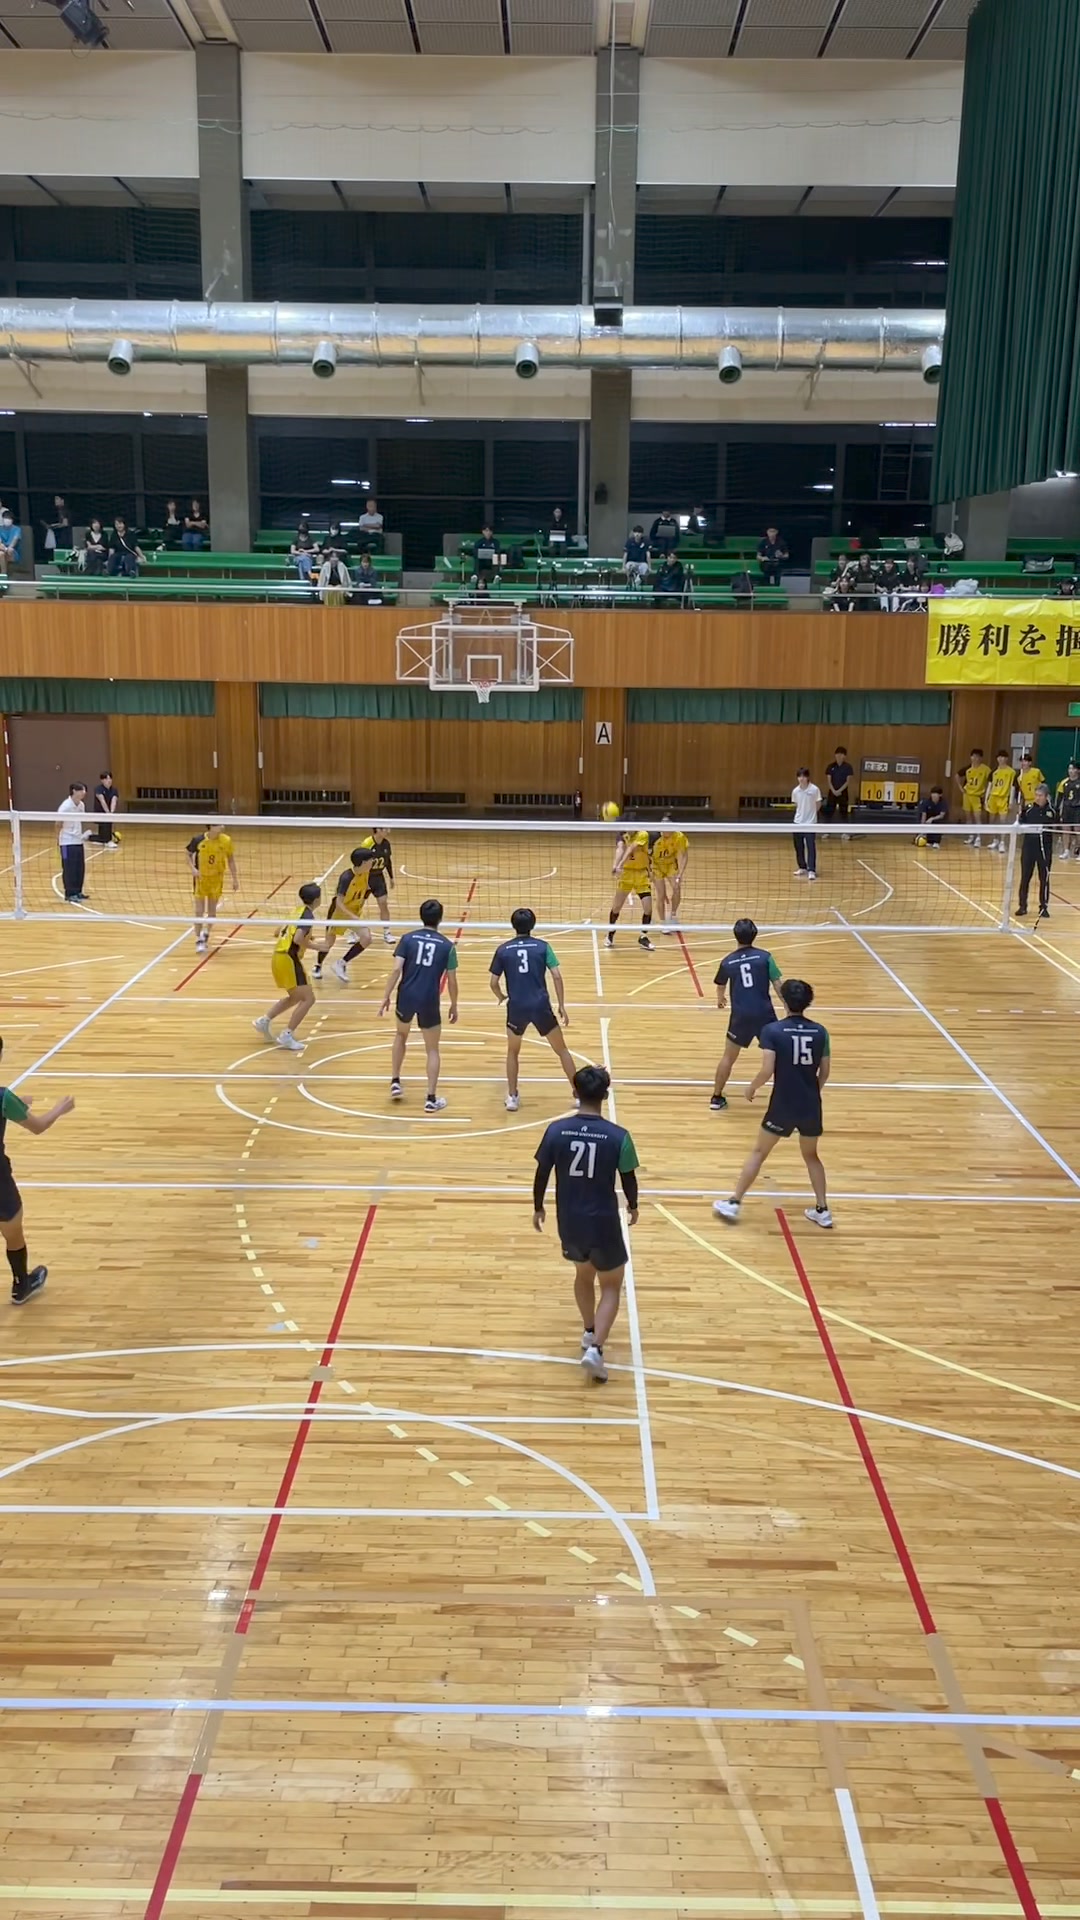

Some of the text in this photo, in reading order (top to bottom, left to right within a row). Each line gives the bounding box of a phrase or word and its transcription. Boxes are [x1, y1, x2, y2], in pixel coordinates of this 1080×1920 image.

[597, 722, 610, 744] A
[208, 854, 215, 865] 8
[372, 857, 385, 870] 22
[415, 940, 437, 967] 13
[516, 949, 529, 974] 3
[740, 963, 754, 988] 6
[791, 1035, 813, 1066] 15
[569, 1140, 597, 1178] 21
